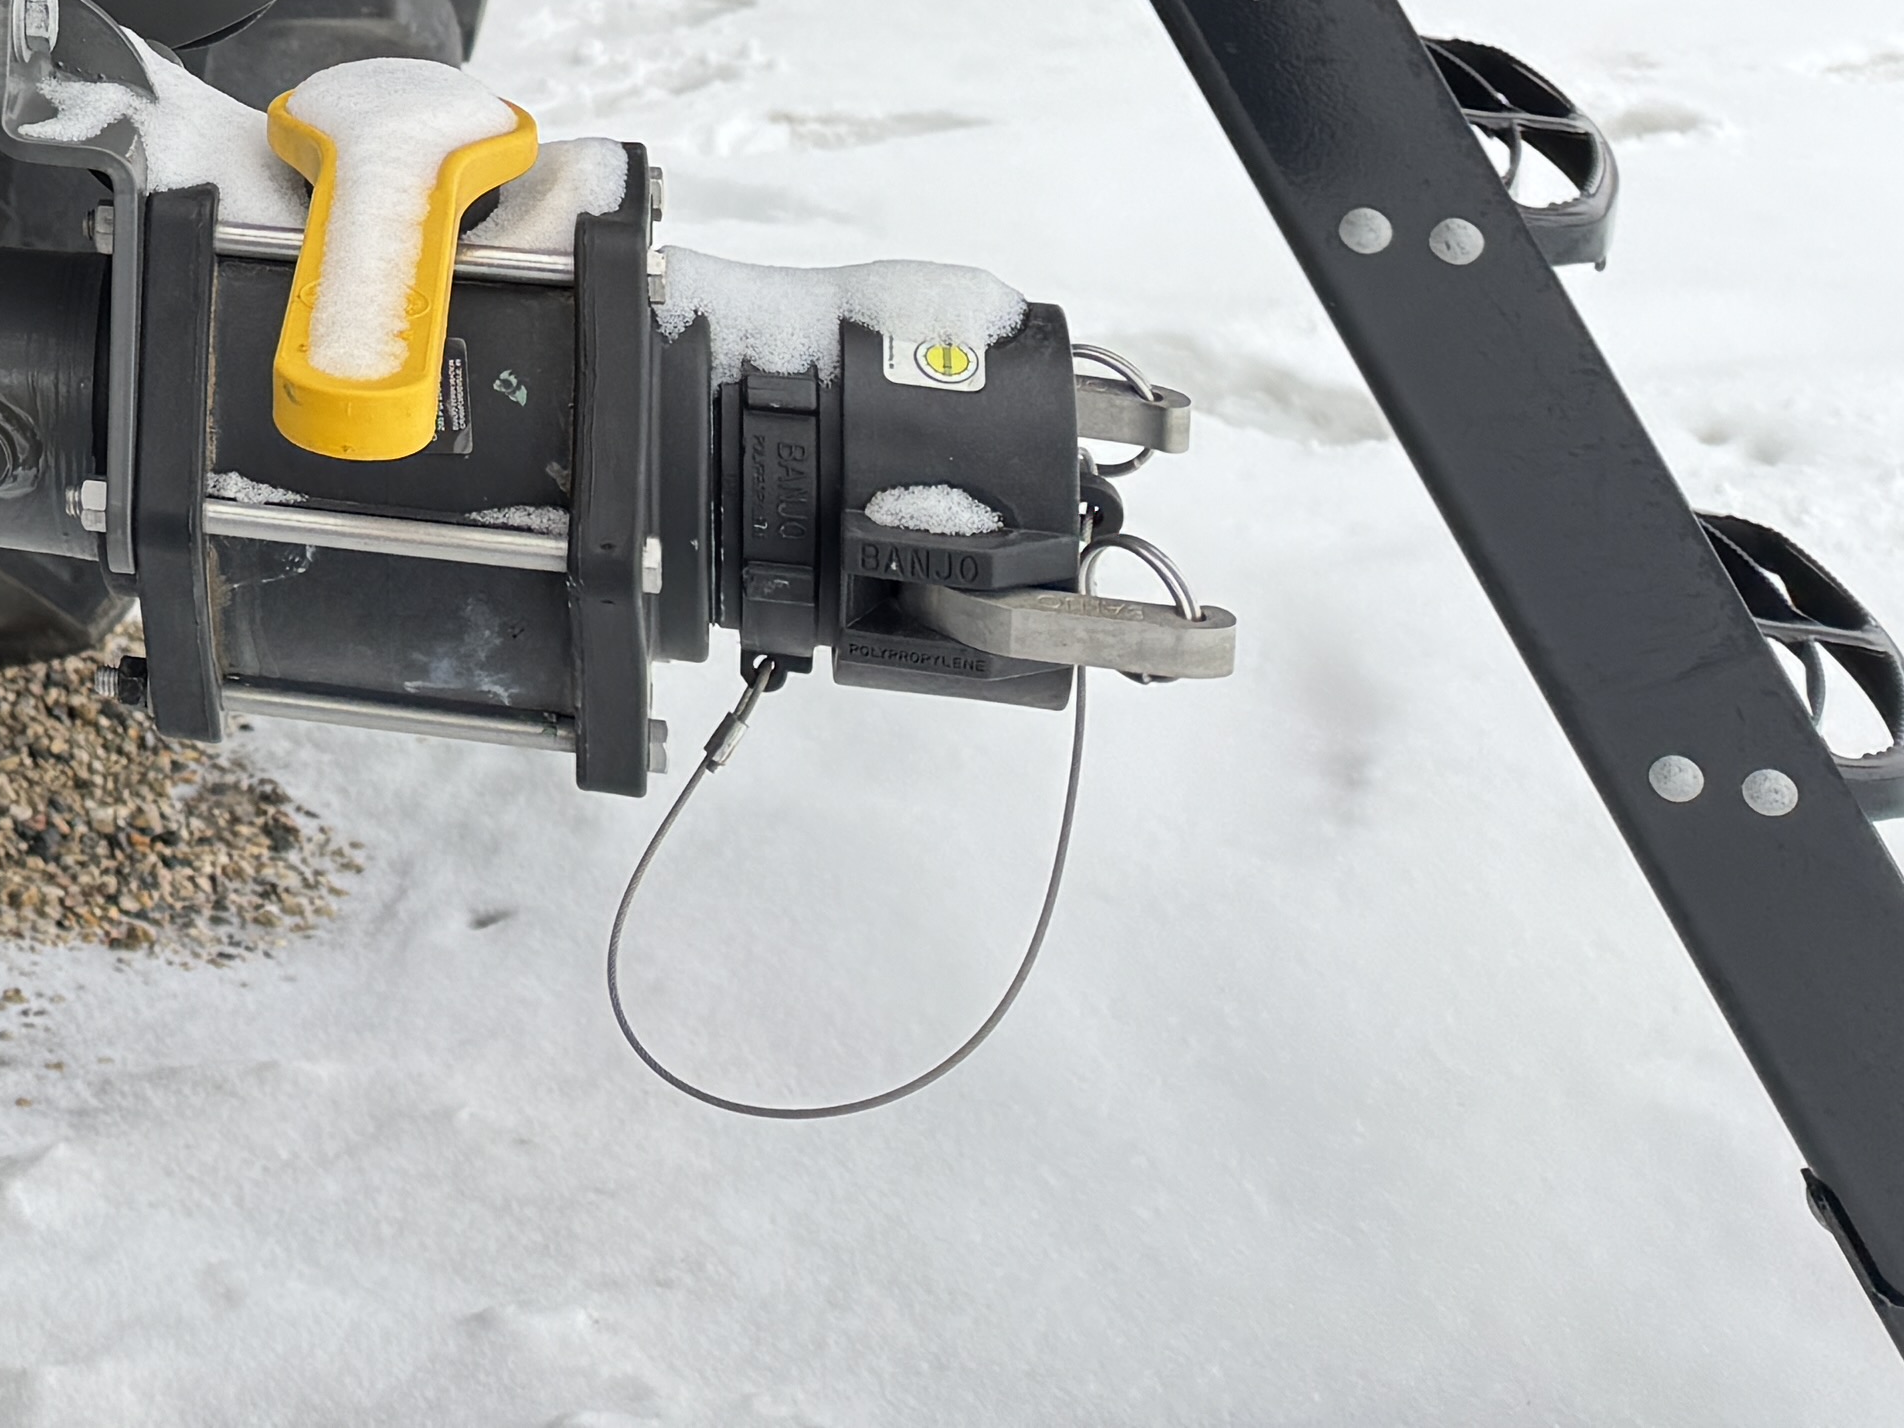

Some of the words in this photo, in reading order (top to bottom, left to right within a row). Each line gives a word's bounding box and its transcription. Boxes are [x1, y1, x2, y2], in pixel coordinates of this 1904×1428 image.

[776, 441, 808, 539] BANJO
[860, 542, 979, 584] BANJO
[848, 642, 987, 673] POLYPROPYLENE
